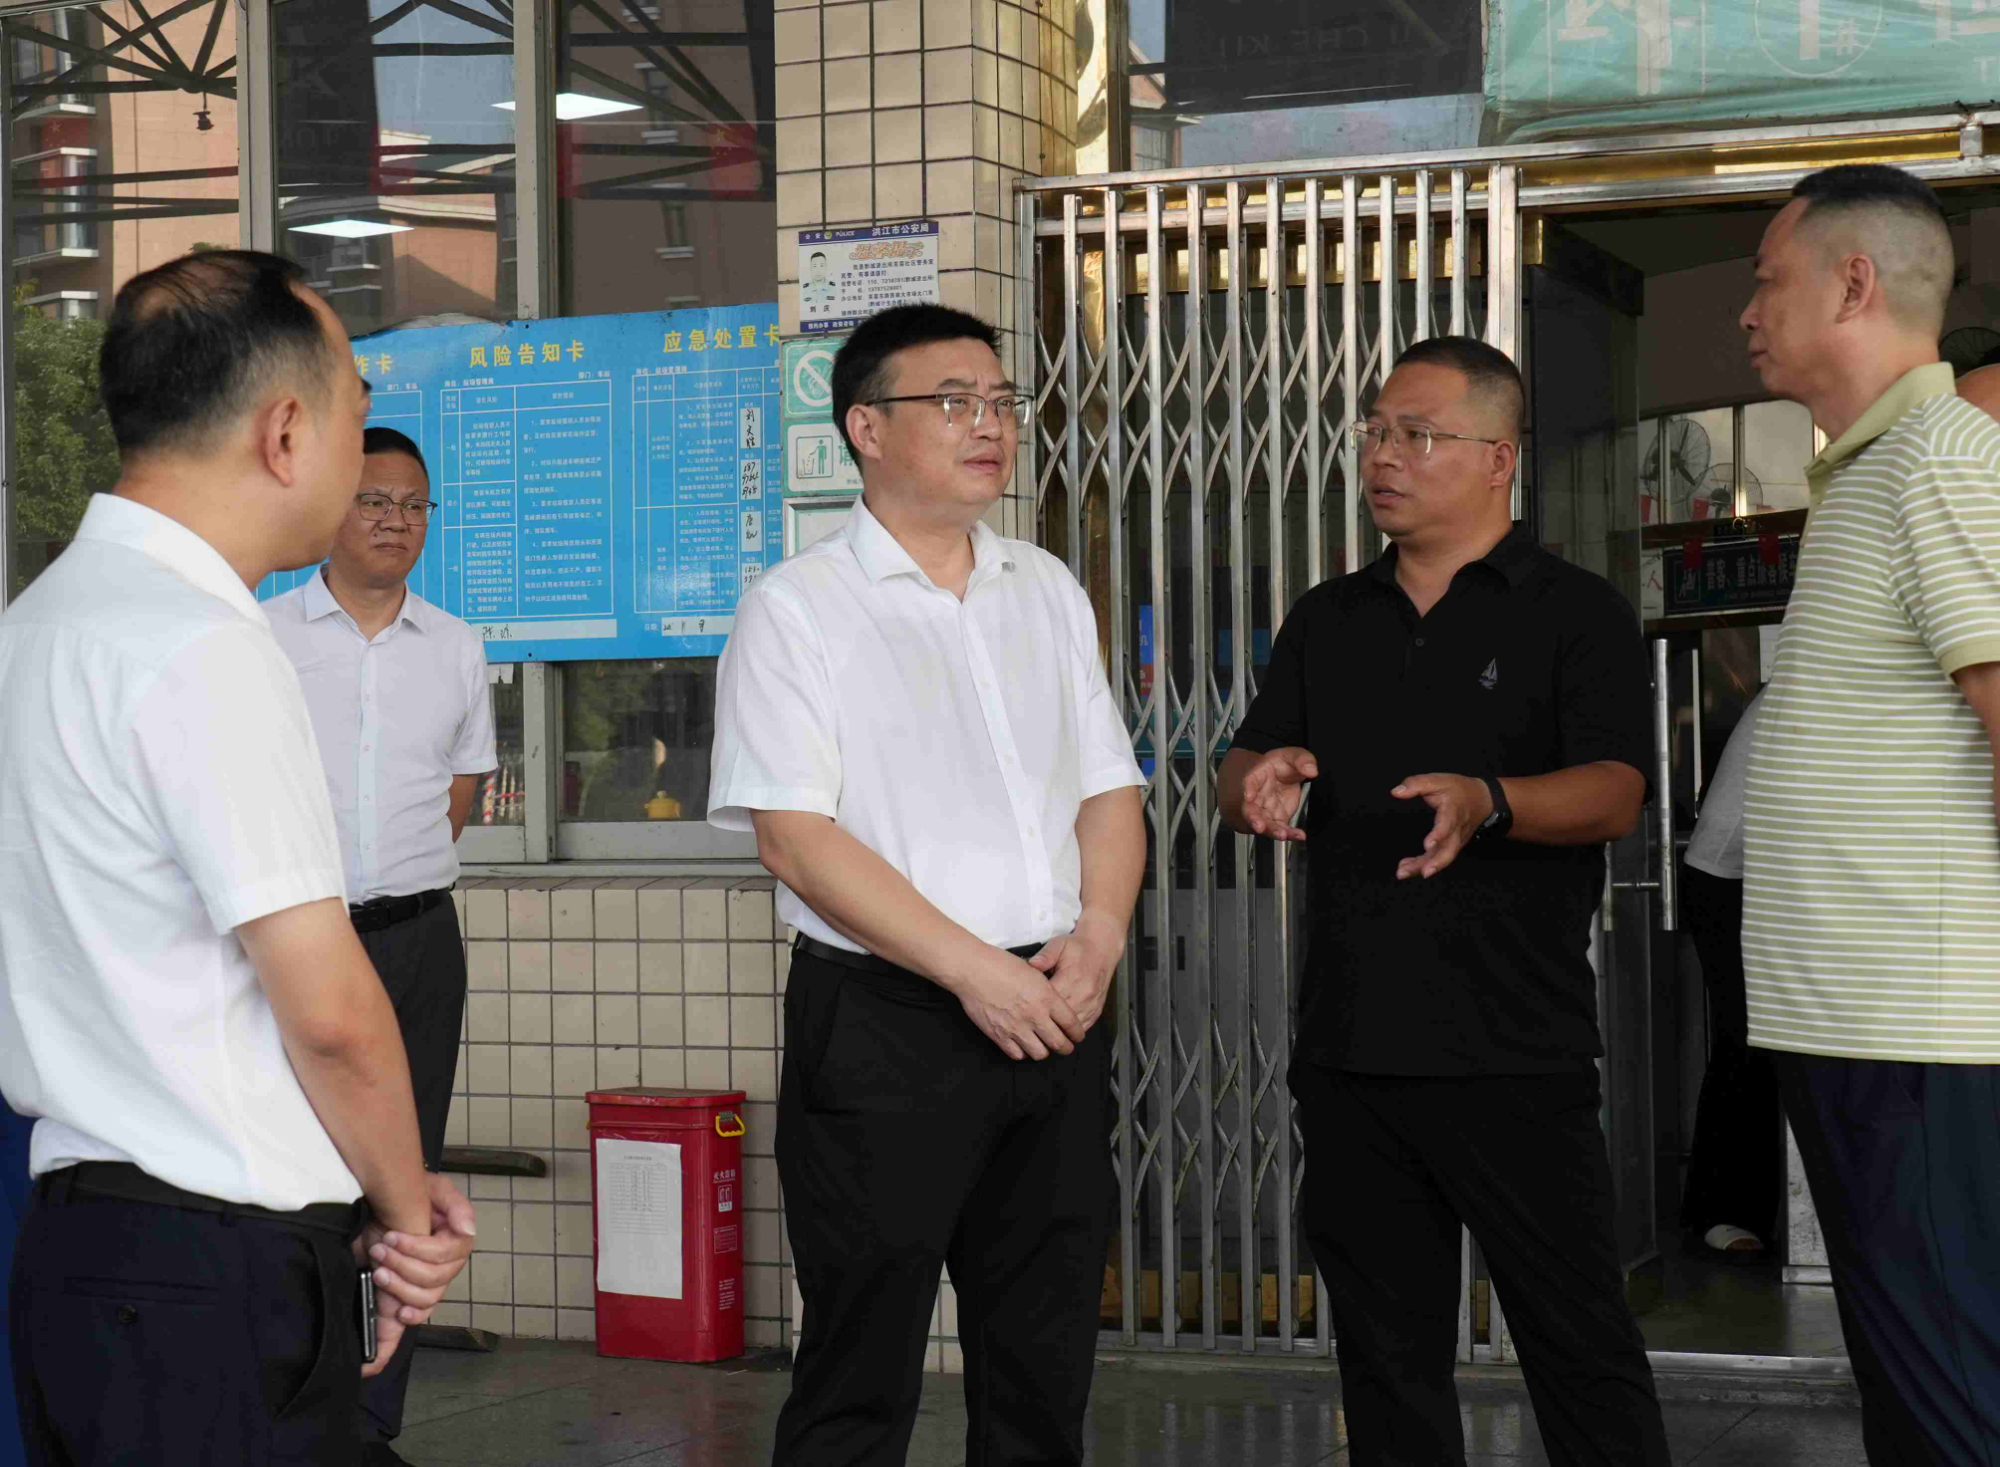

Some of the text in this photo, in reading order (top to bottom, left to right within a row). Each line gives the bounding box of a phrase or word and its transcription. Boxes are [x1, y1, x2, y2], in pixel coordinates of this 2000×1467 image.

[872, 223, 929, 236] 洪江市公安局
[663, 323, 780, 353] 应急处置卡
[469, 340, 585, 368] 风险告知卡
